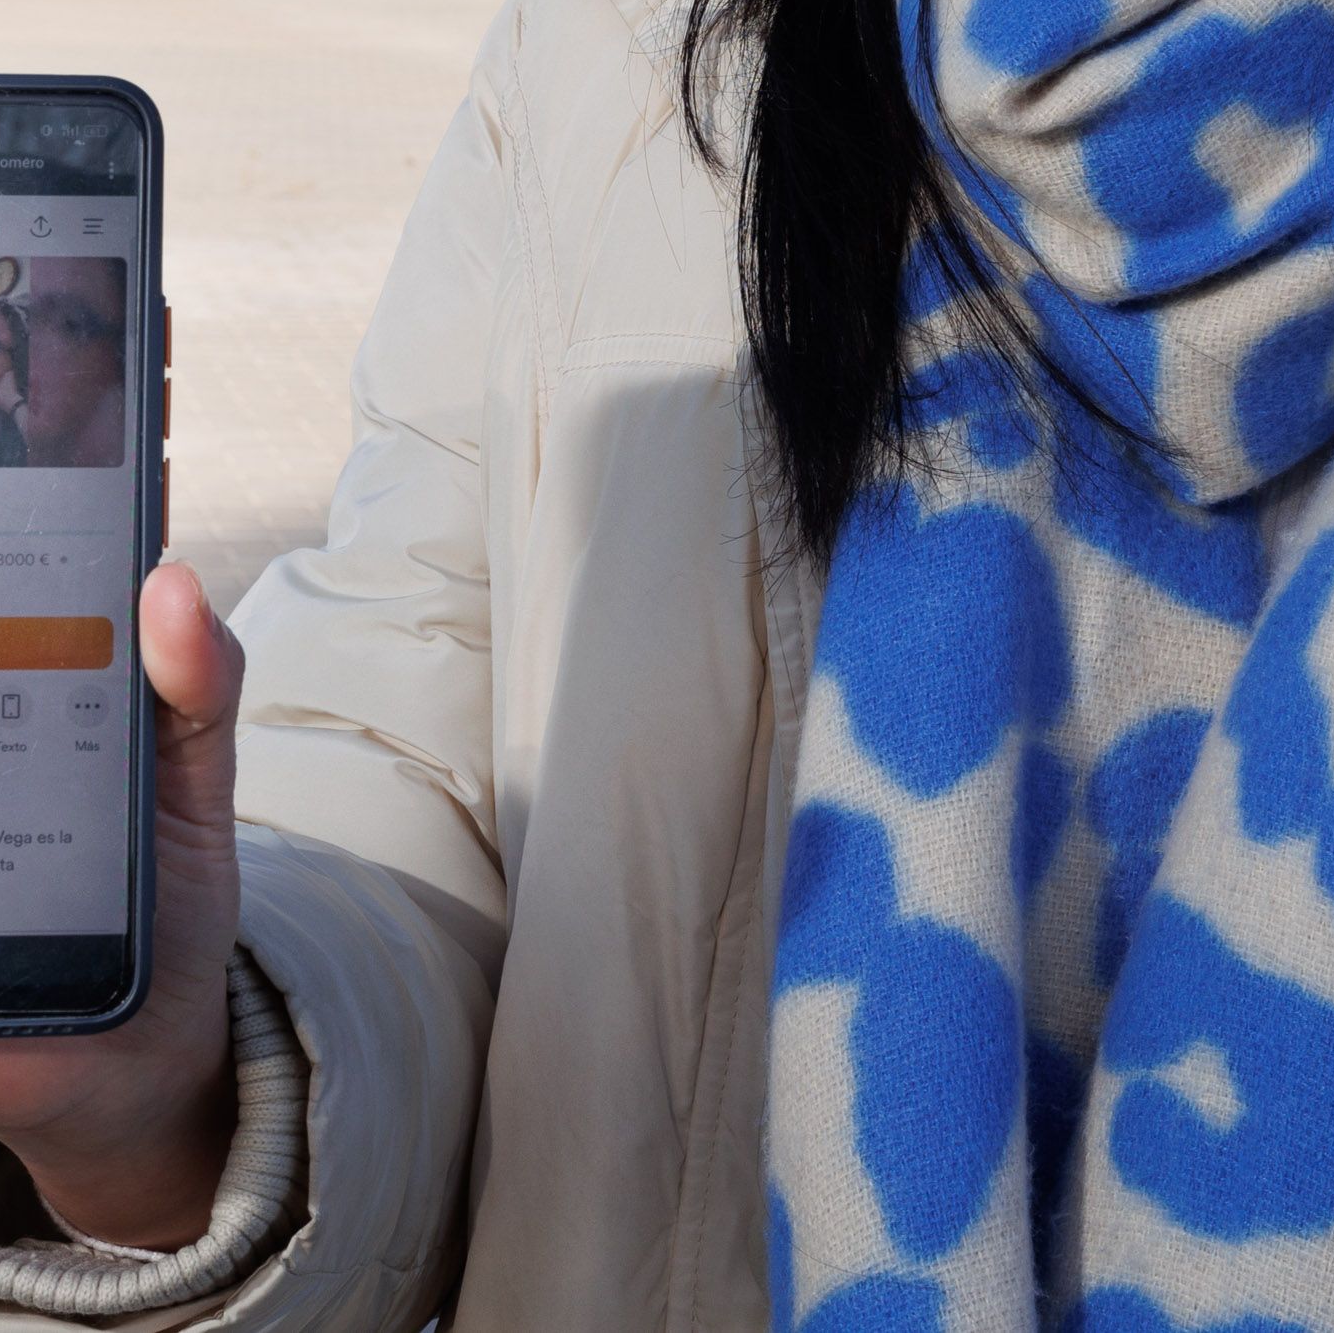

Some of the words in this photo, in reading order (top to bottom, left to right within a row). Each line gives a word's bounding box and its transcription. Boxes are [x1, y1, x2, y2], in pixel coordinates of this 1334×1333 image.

[39, 553, 51, 566] €
[74, 739, 101, 752] Más
[36, 832, 56, 845] es
[59, 829, 74, 845] la
